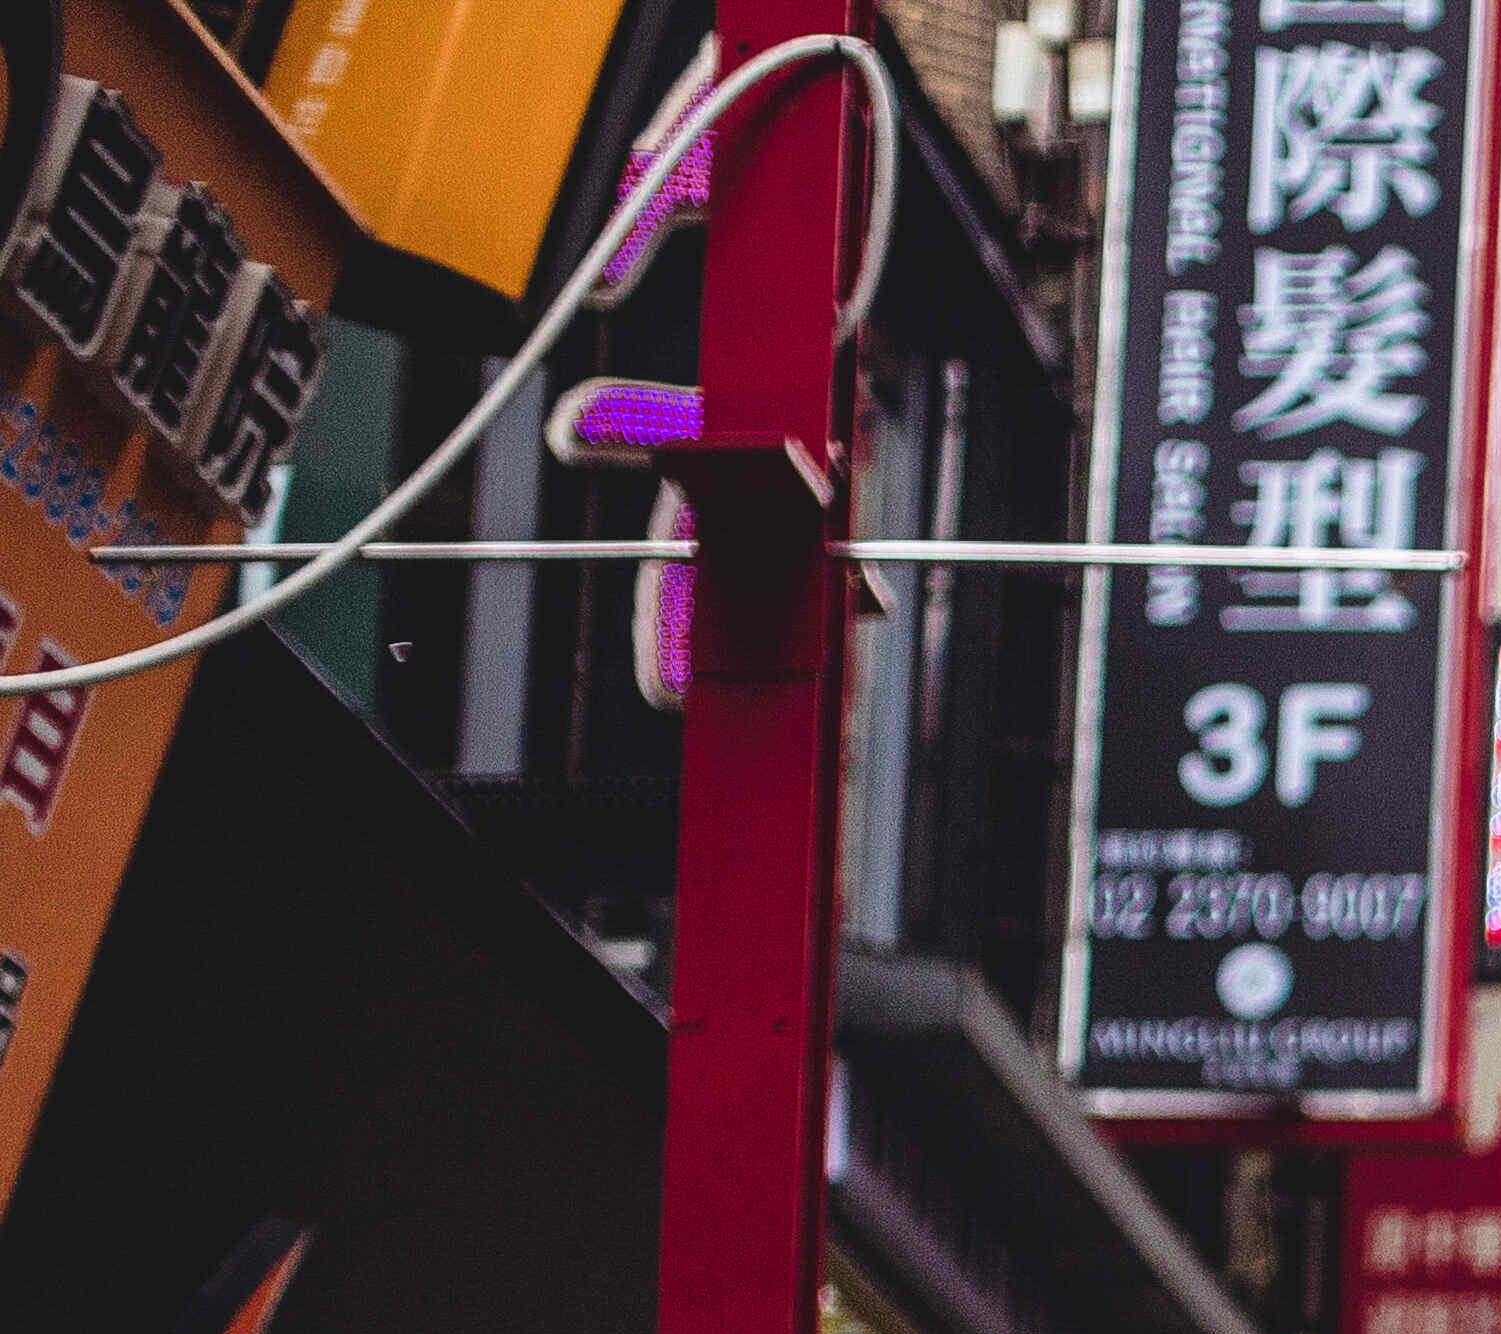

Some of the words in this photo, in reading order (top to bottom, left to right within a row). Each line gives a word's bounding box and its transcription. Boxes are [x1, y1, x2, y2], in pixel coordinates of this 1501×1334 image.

[1218, 0, 1446, 632] 際髮型
[1177, 682, 1373, 808] 3F
